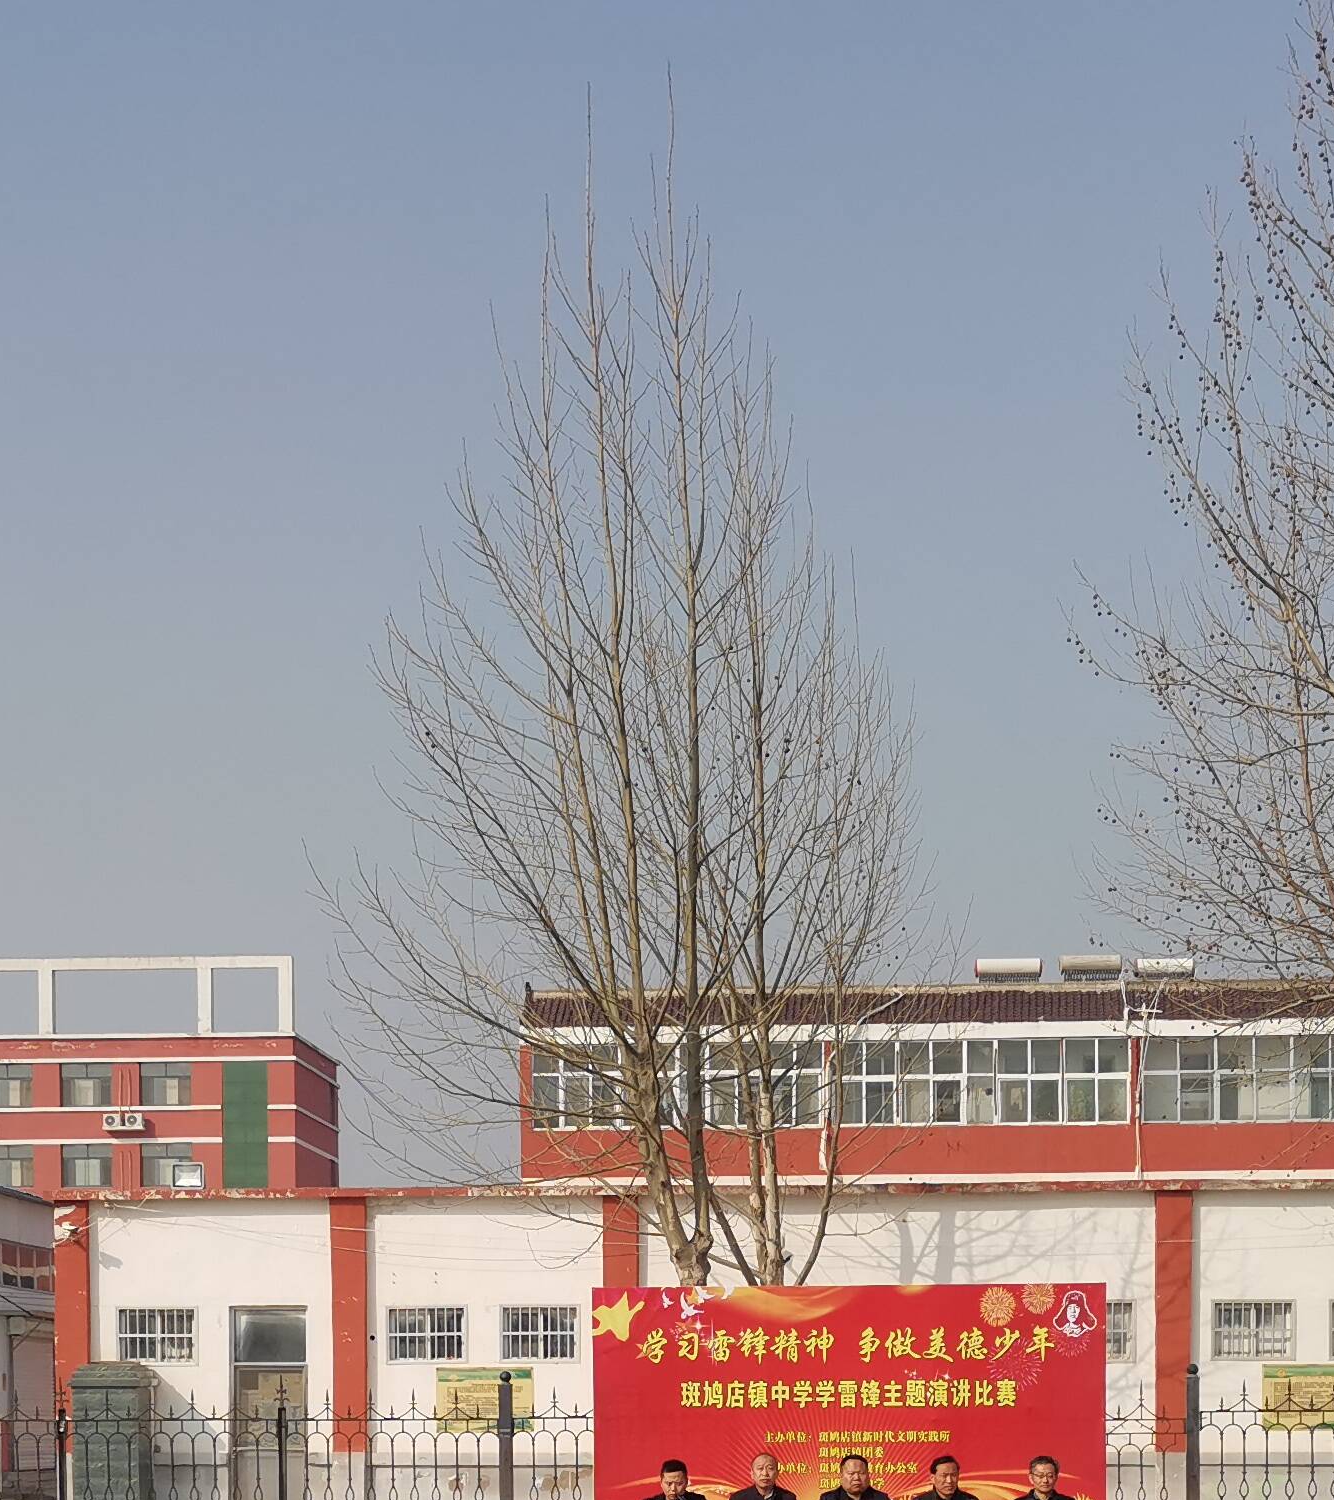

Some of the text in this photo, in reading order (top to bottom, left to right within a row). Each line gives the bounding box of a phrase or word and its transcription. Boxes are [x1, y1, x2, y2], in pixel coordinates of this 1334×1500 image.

[642, 1326, 1055, 1365] 学习雷锋精神 争做美德少年
[680, 1378, 1017, 1409] 斑鸠店镇中学学雷锋主题演讲比赛
